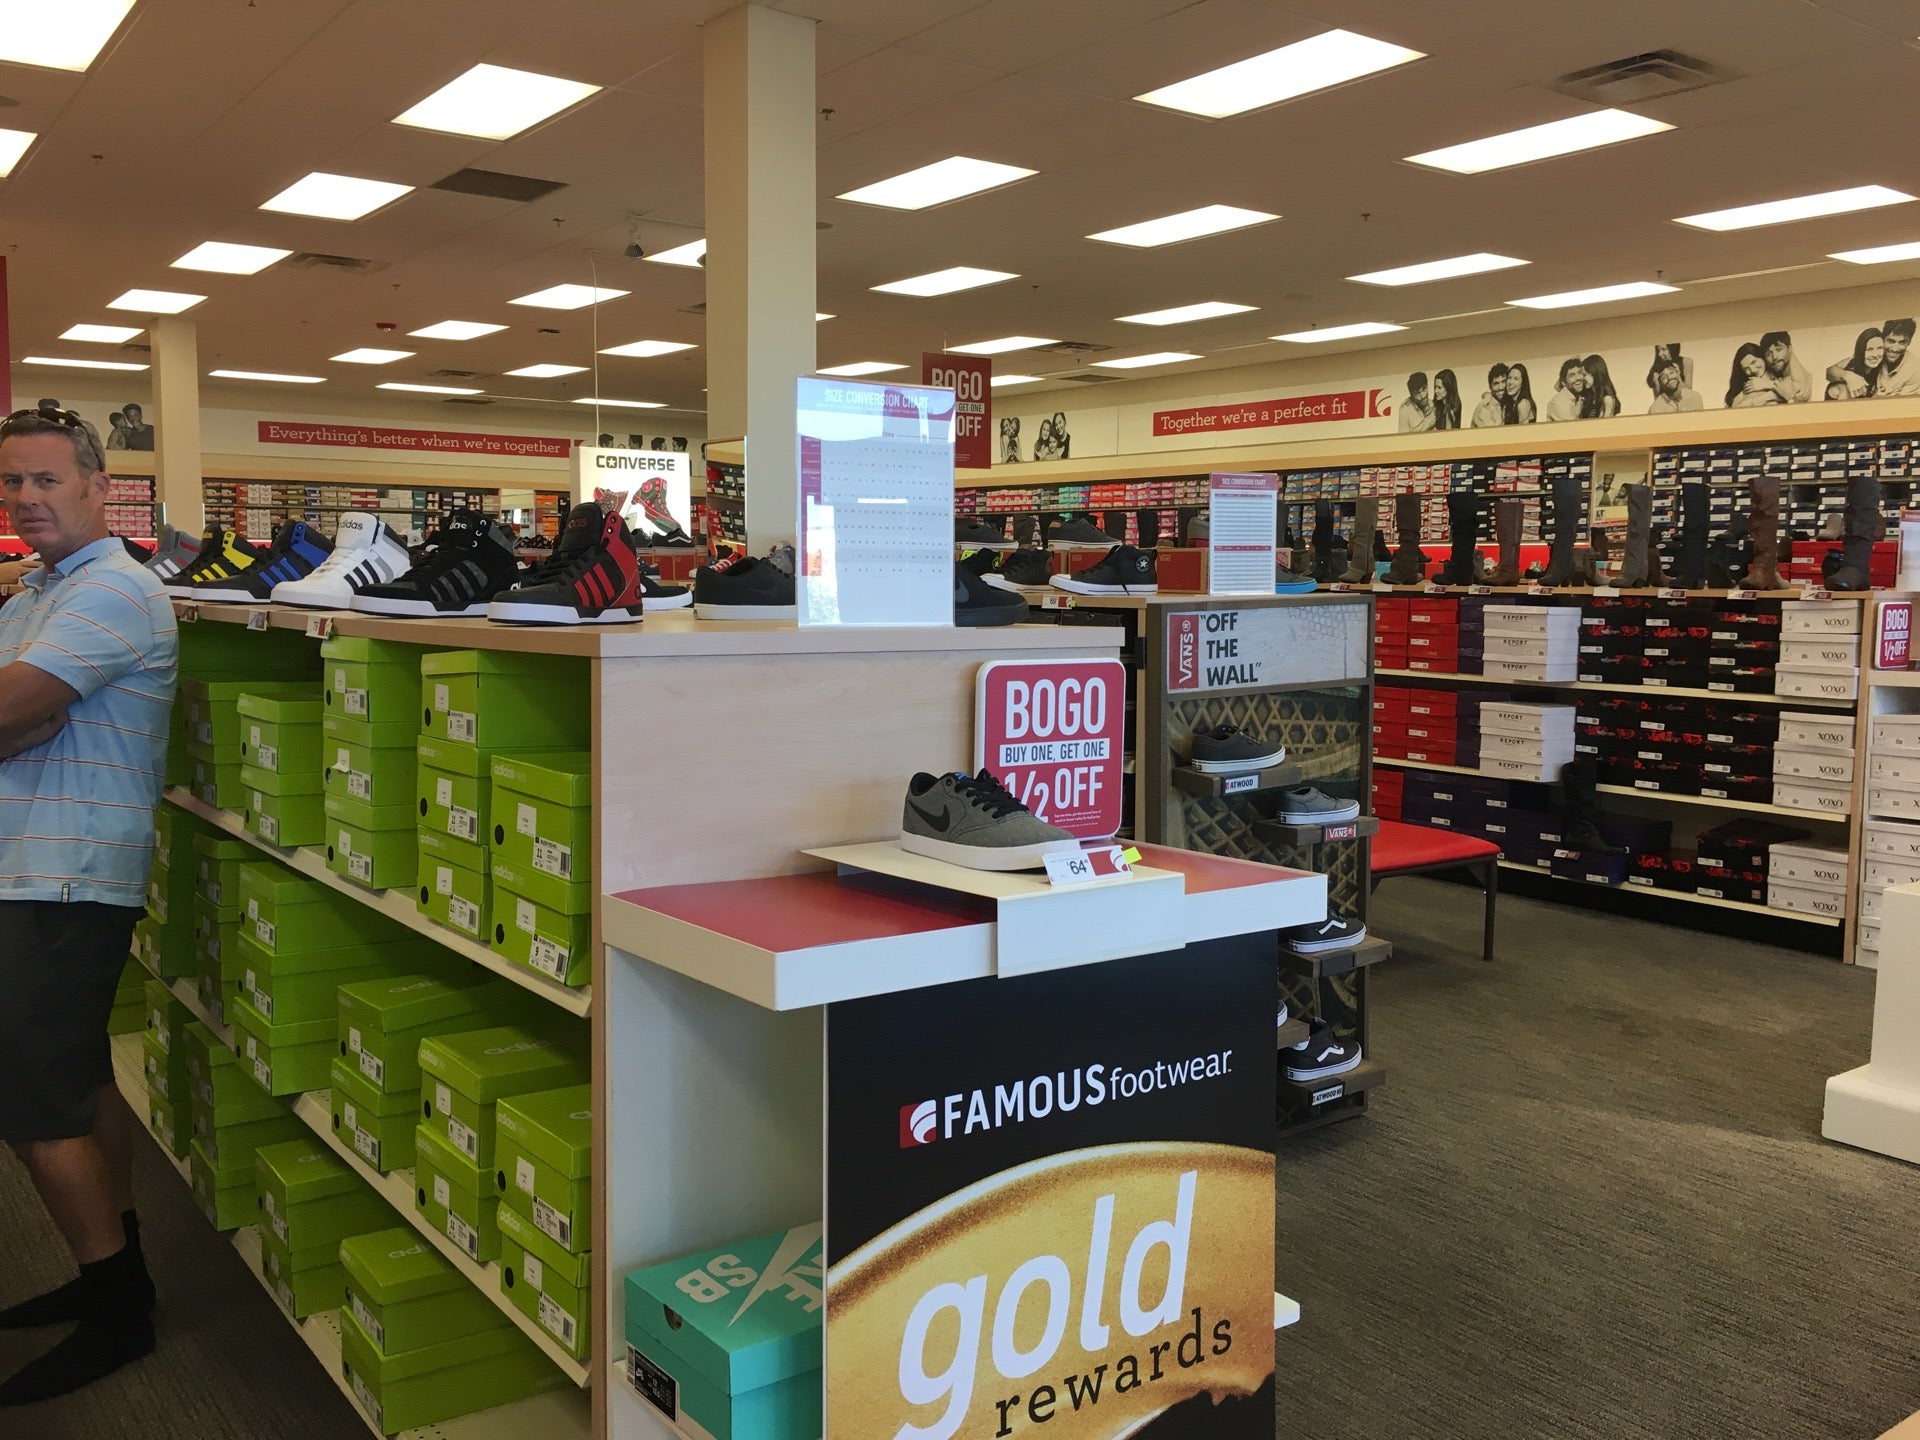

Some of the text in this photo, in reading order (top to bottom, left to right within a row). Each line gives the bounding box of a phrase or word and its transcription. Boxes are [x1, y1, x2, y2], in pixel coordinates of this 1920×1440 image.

[932, 368, 982, 400] BOGO
[824, 388, 844, 402] SIZE
[846, 391, 900, 407] CONVERSION
[902, 394, 929, 410] CHART
[958, 403, 982, 412] GET ONE
[1160, 398, 1348, 431] Together we're a perfect fit
[957, 415, 982, 437] OFF
[269, 425, 561, 454] Everything's better when we're together
[596, 455, 675, 471] CONVERSE
[1824, 618, 1849, 626] XOXO
[1886, 608, 1908, 630] BOGO
[1206, 639, 1238, 659] THE
[1821, 651, 1847, 660] XOXO
[1895, 640, 1907, 656] OFF
[1820, 685, 1846, 693] XOXO
[1005, 677, 1106, 739] BOGO
[1818, 732, 1844, 742] XOXO
[1005, 741, 1104, 763] BUY ONE, GET ONE
[1819, 765, 1844, 775] XOXO
[1054, 765, 1104, 809] OFF
[1230, 778, 1254, 790] ATWOOD
[1818, 798, 1843, 807] XOXO
[1814, 870, 1840, 880] XOXO
[1812, 901, 1838, 912] XOXO
[944, 1050, 1233, 1139] FAMOUS footwear
[1315, 1090, 1337, 1101] ATWOOD
[675, 1254, 758, 1303] SB
[893, 1170, 1198, 1440] gold
[994, 1307, 1233, 1438] rewards
